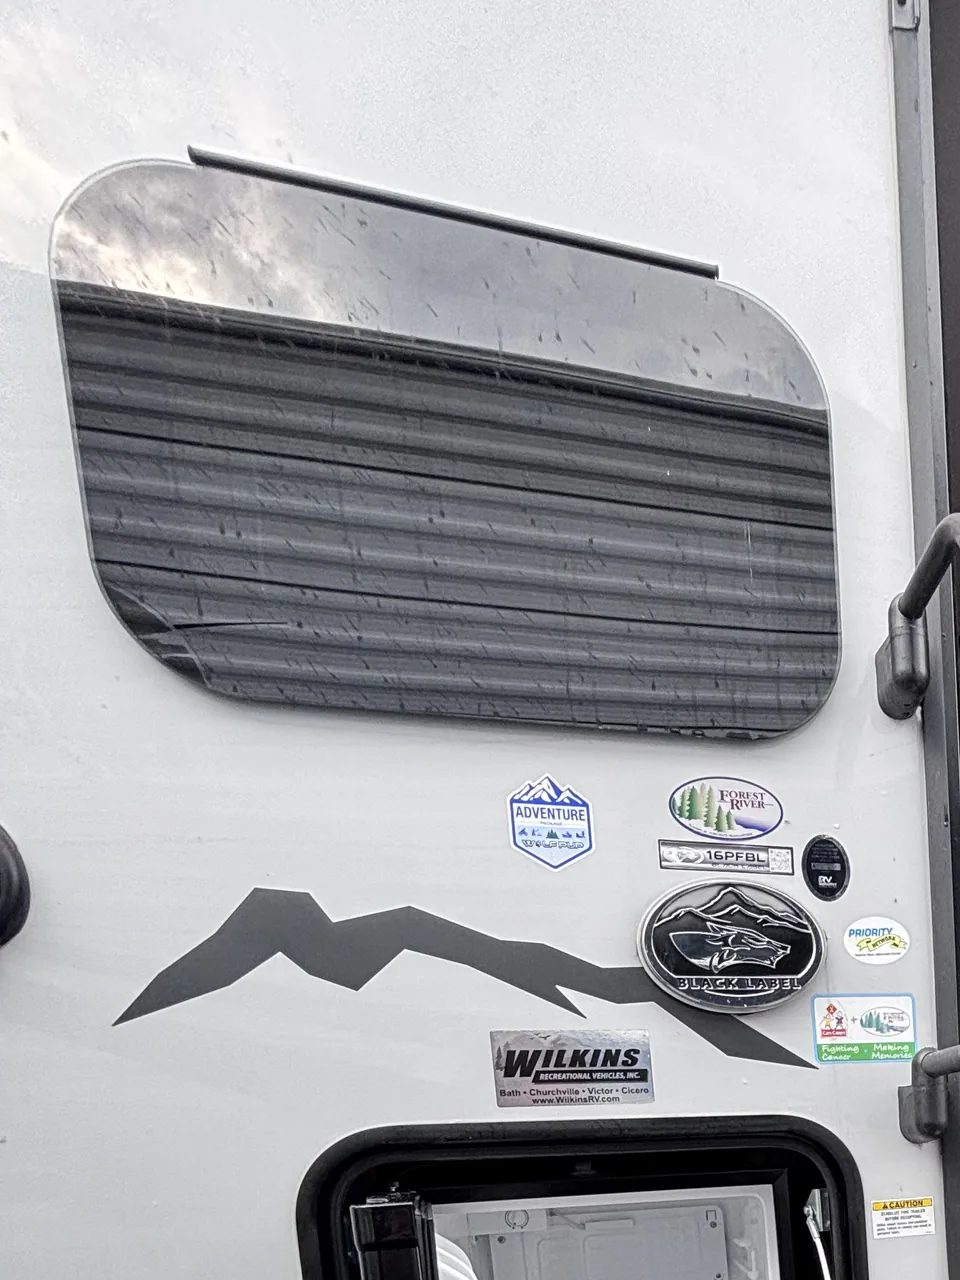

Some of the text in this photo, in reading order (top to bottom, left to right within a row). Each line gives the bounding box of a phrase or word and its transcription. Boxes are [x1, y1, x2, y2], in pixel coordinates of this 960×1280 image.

[718, 790, 766, 803] FOREST
[730, 799, 766, 811] RIVER
[516, 805, 586, 821] ADVENTURE
[706, 850, 766, 863] 16PFBL
[818, 875, 833, 884] RV
[848, 927, 894, 938] PRIORITY
[871, 935, 896, 949] NETWORK
[678, 977, 802, 990] BLACK LABEL
[821, 1044, 860, 1054] Fighting
[873, 1043, 910, 1052] Making
[821, 1053, 851, 1061] Cancer
[871, 1051, 913, 1060] Memories
[503, 1048, 641, 1078] WILKINS
[539, 1071, 641, 1081] RECREATIONAL VEHICLES, INC.
[499, 1086, 649, 1097] Bath Churchville Victor Cicero
[531, 1095, 620, 1105] www.WilkinsRV.com
[889, 1199, 924, 1209] CAUTION
